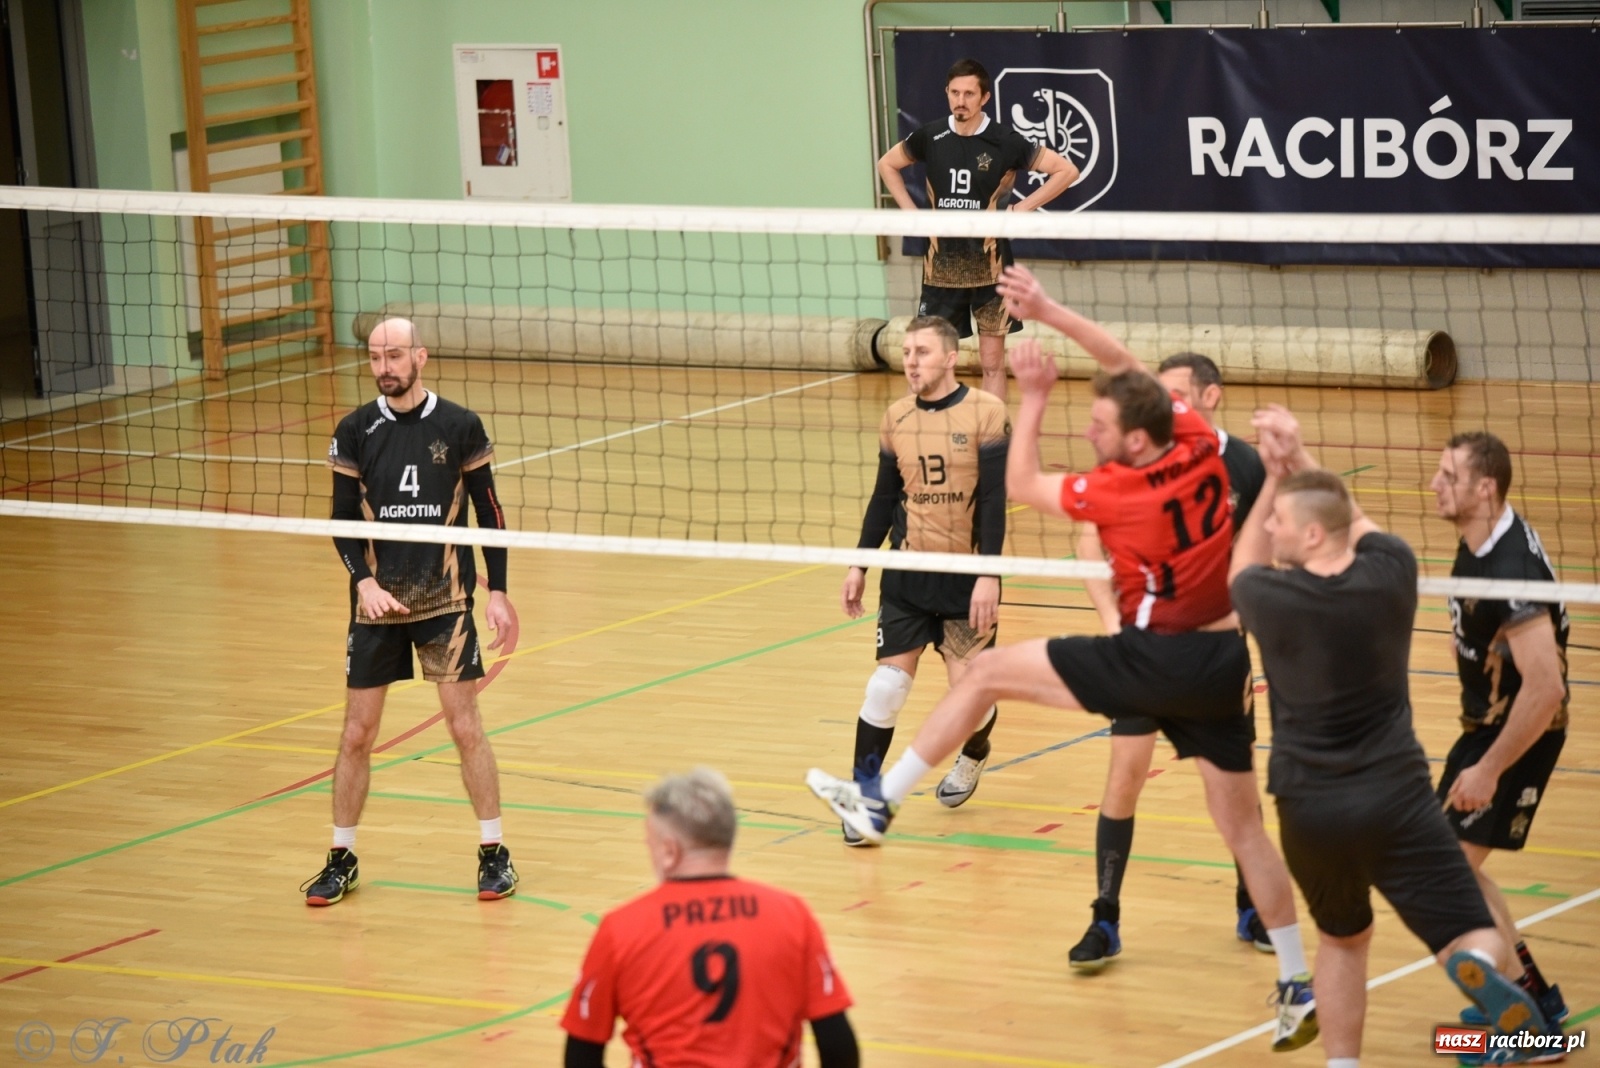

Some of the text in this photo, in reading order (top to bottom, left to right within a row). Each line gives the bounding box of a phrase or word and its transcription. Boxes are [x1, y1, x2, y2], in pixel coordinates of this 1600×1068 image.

[1188, 94, 1574, 181] RACIBÓRZ
[949, 168, 972, 194] 19
[938, 198, 980, 210] AGROTIM
[399, 465, 420, 498] 4
[918, 455, 946, 485] 13
[379, 504, 441, 519] AGROTIM
[912, 491, 964, 504] AGROTIM
[1163, 474, 1222, 552] 12
[662, 895, 759, 929] PAZIU
[691, 940, 740, 1025] 9
